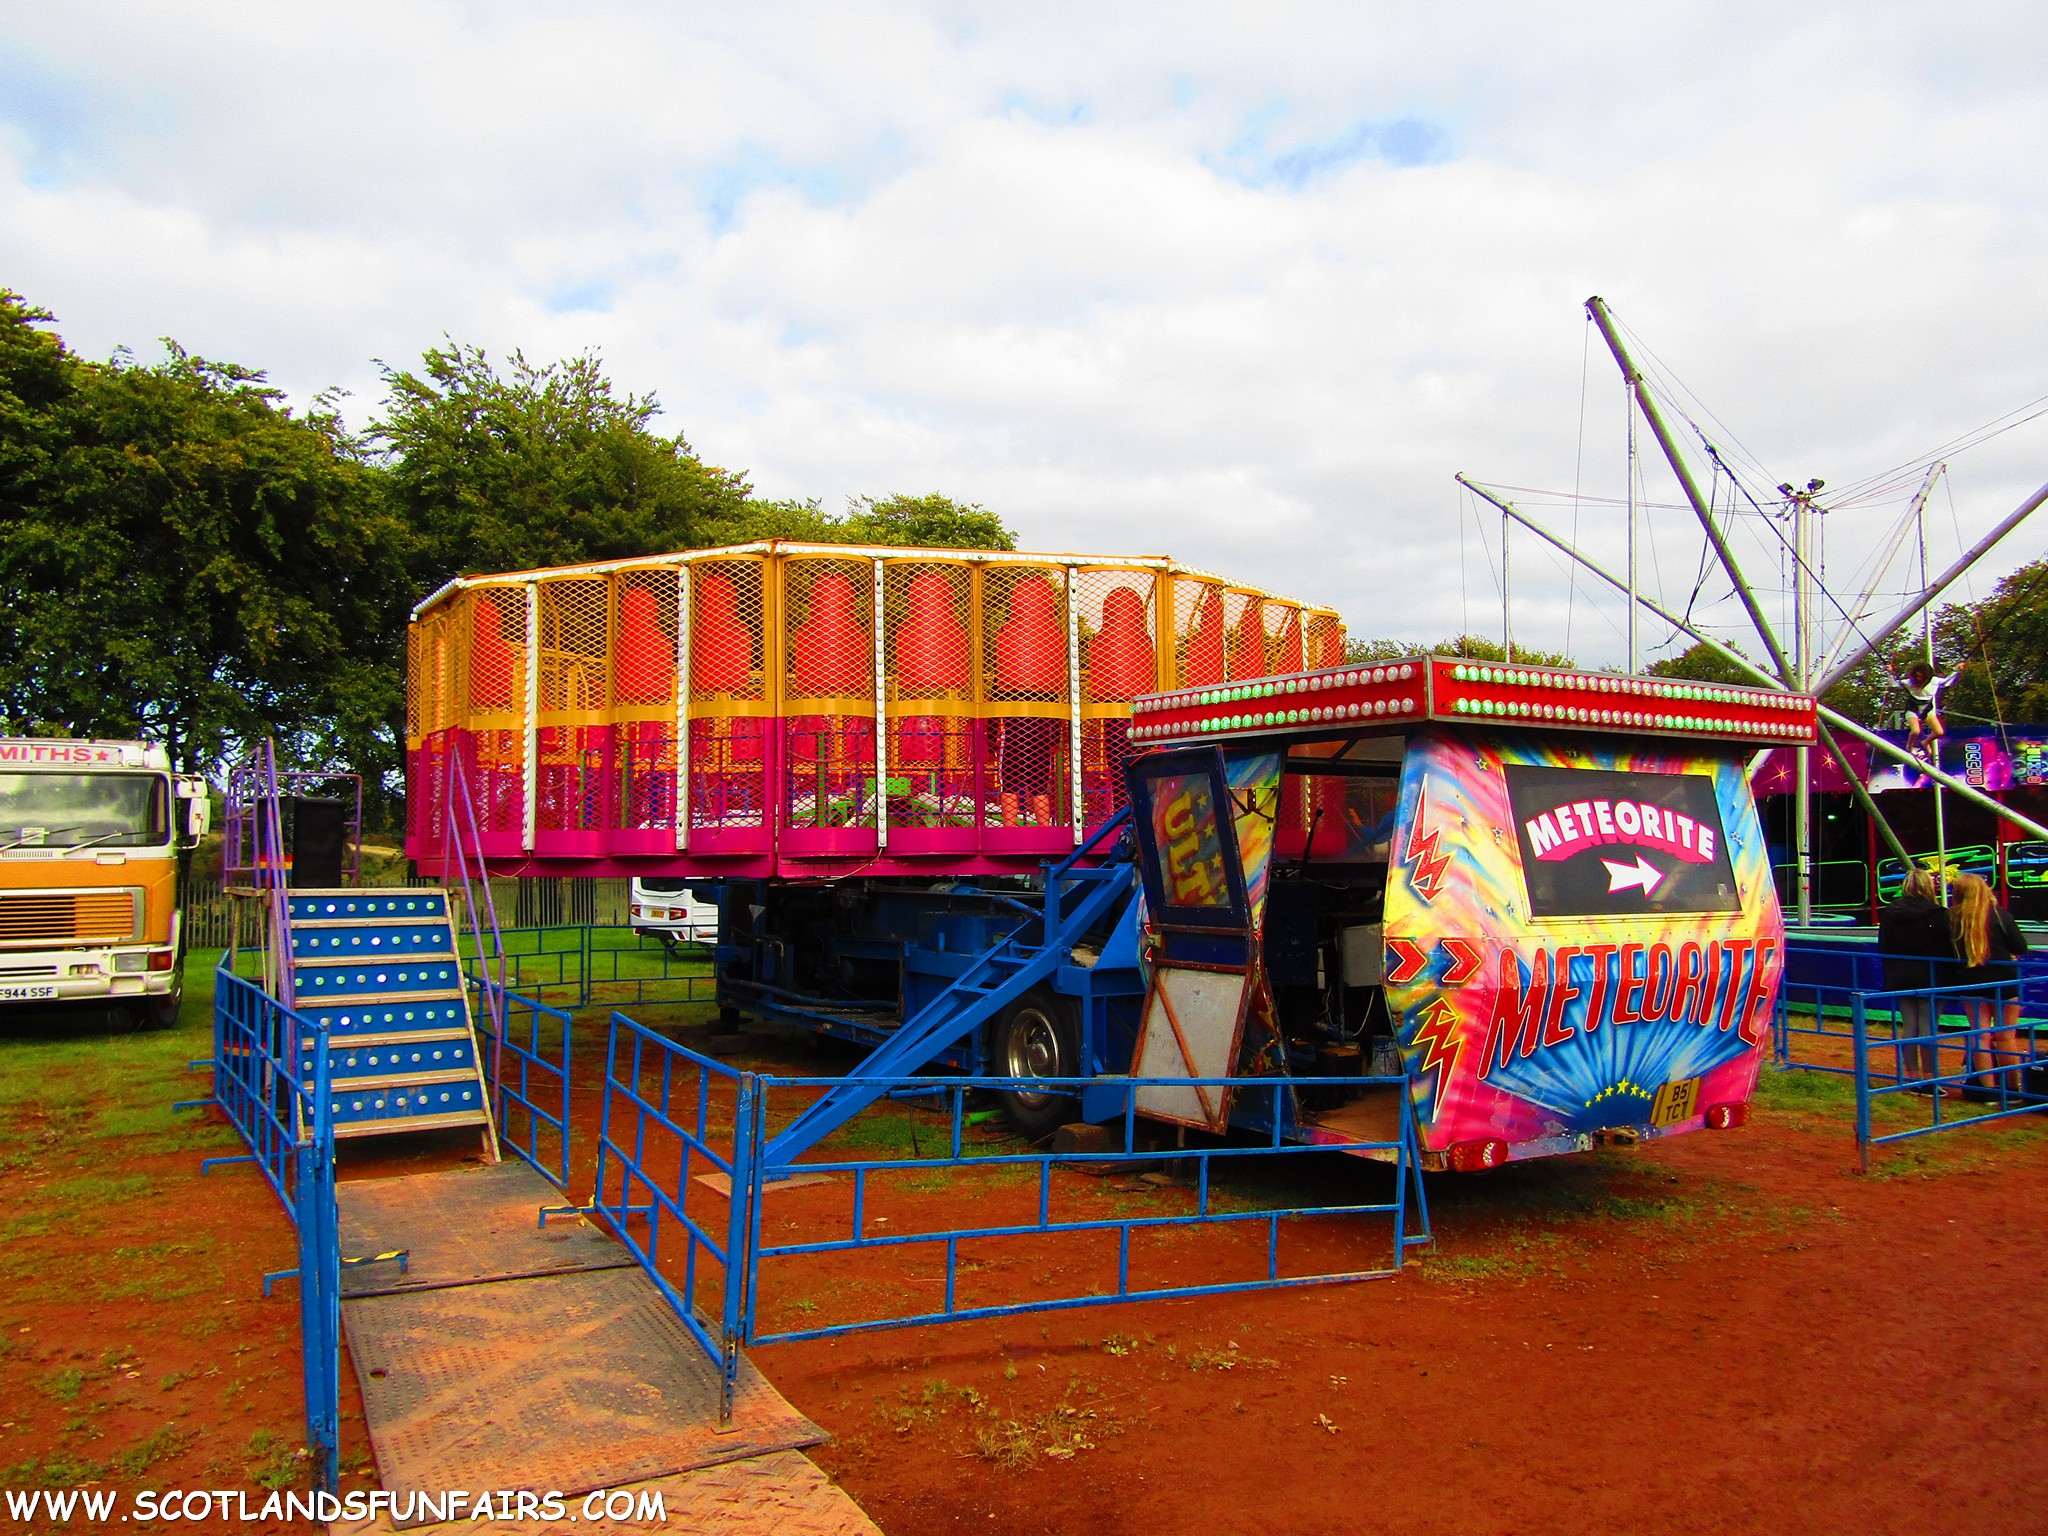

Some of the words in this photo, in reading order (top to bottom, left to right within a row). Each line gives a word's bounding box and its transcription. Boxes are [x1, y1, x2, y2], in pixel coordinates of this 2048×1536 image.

[1164, 790, 1217, 905] ULT
[1525, 799, 1716, 863] METEORITE
[31, 987, 53, 997] SSF
[1477, 938, 1776, 1080] METEORITE
[1665, 1101, 1689, 1121] TCT
